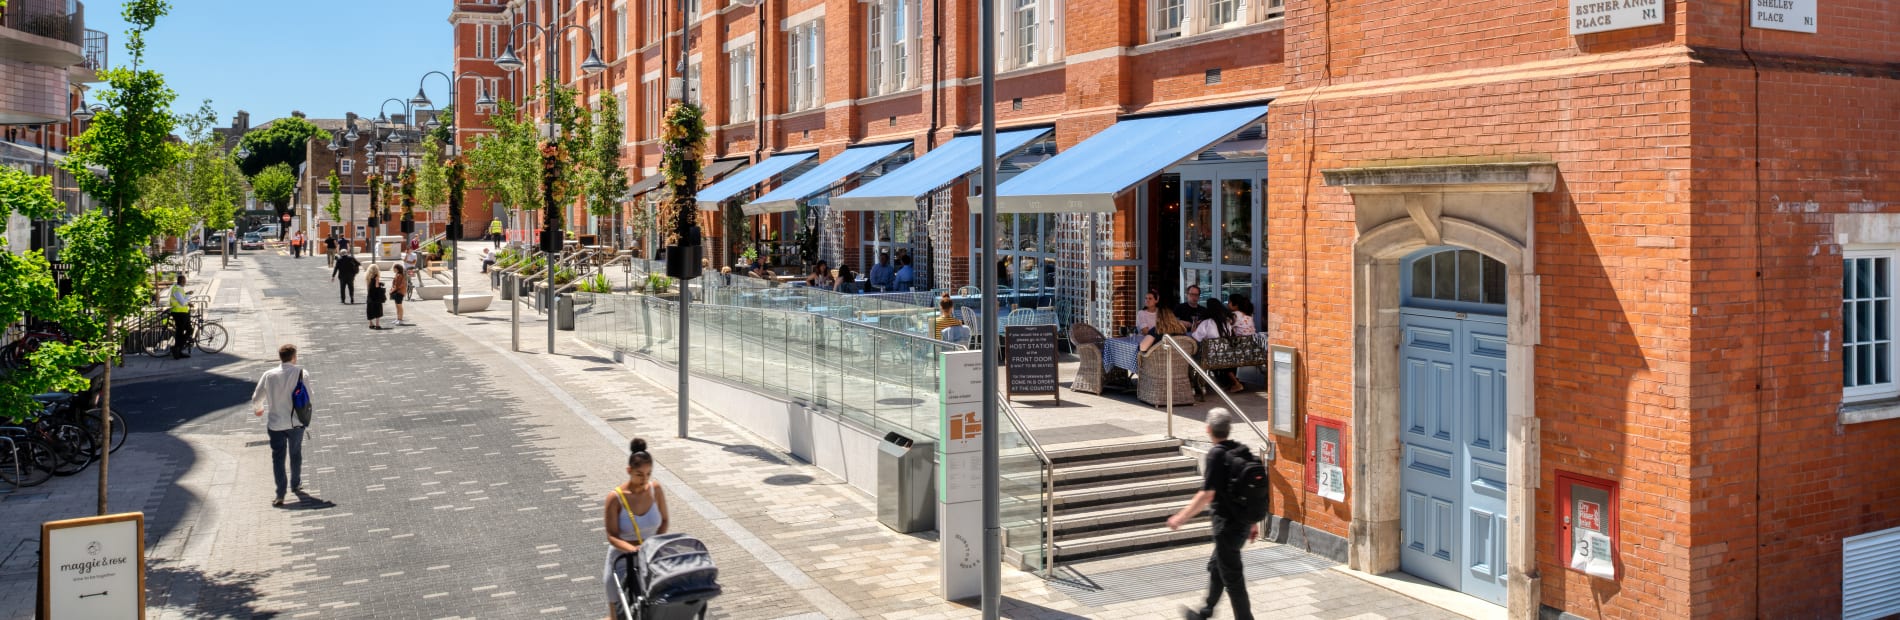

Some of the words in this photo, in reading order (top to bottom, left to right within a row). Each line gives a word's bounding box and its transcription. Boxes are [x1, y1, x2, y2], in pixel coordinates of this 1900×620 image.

[1576, 1, 1620, 15] ESTHER
[1757, 0, 1794, 9] SHELLEY
[1576, 15, 1612, 29] PLACE
[1642, 8, 1657, 20] N1
[1758, 11, 1784, 23] PLACE
[1804, 16, 1814, 26] N1
[1322, 471, 1328, 486] 2
[1579, 540, 1589, 557] 3
[61, 558, 100, 574] maggie
[102, 556, 108, 566] &
[109, 556, 127, 565] rose
